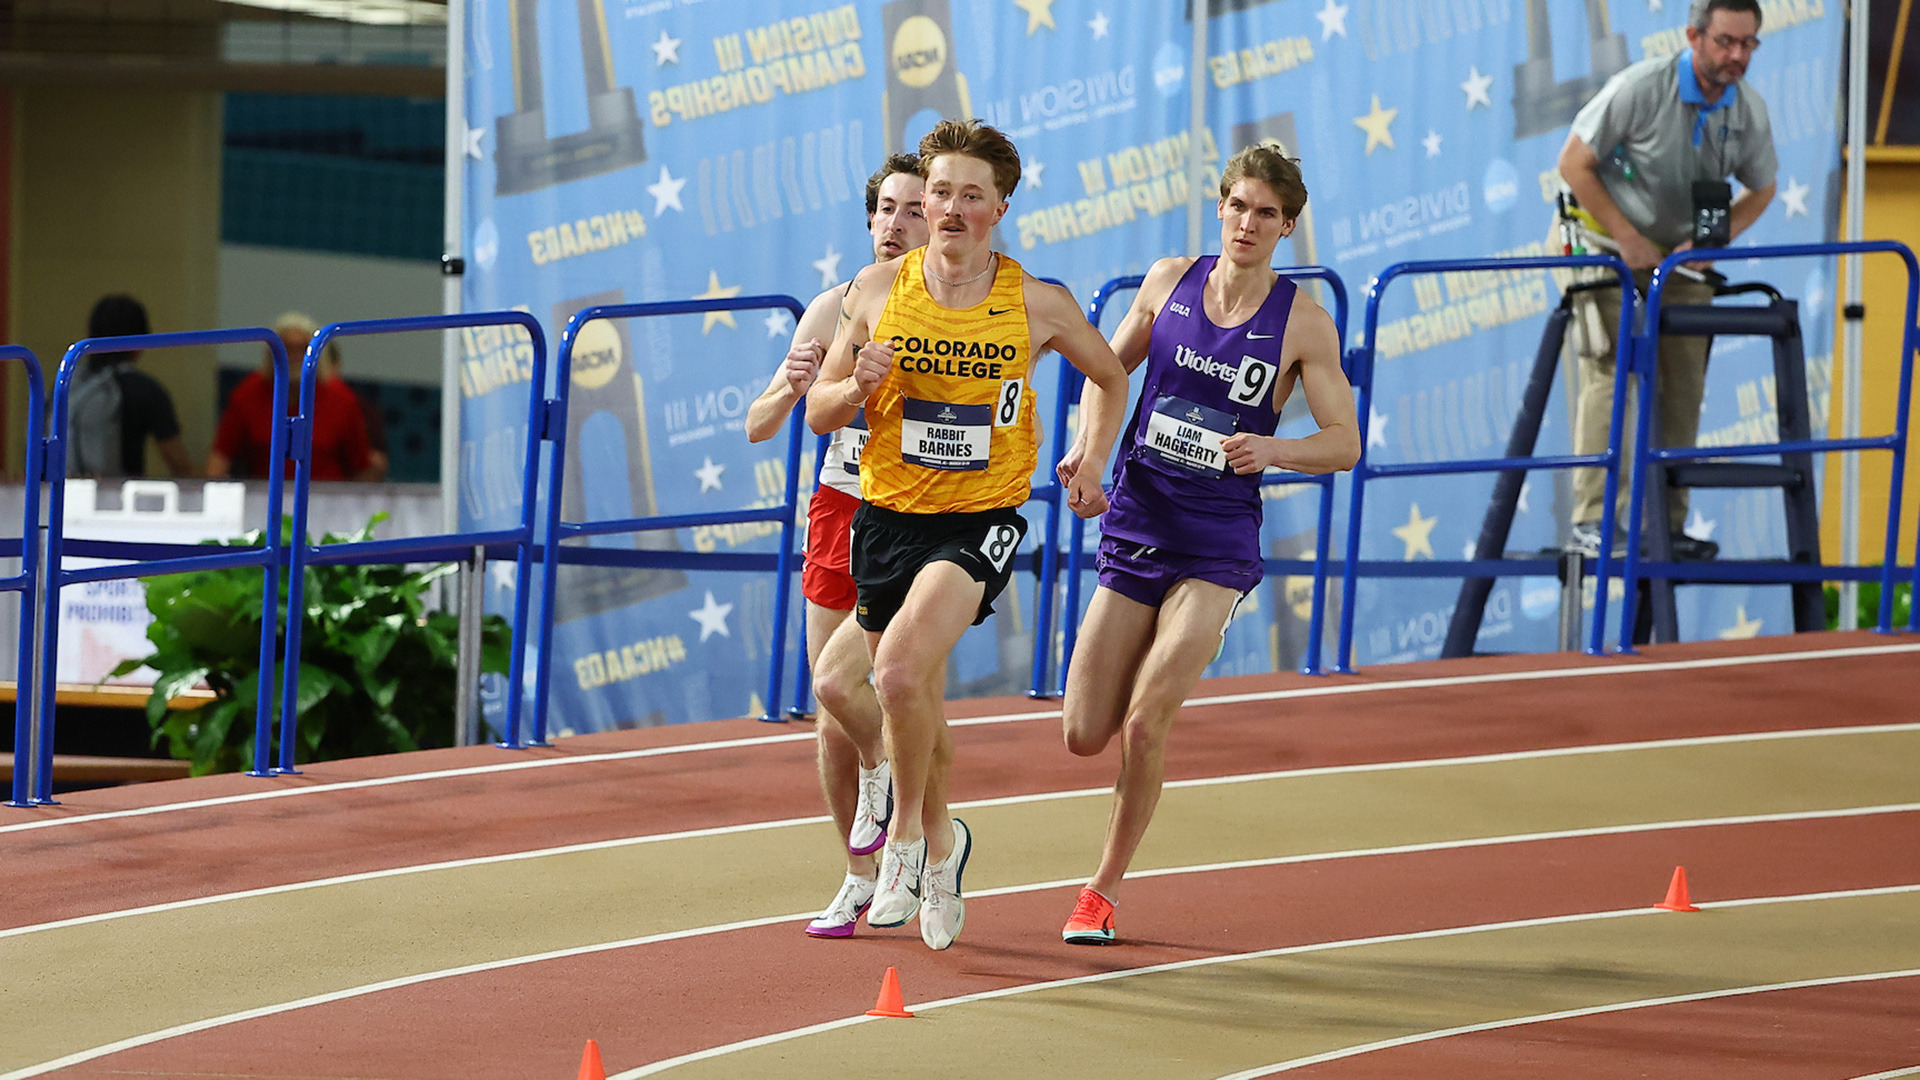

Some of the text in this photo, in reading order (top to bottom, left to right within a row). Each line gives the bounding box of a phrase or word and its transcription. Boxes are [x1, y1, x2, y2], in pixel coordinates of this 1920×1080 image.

[1170, 302, 1191, 318] UAA
[891, 335, 1016, 361] COLORADO
[900, 355, 1003, 379] COLLEGE
[1174, 343, 1238, 384] Violets
[1238, 362, 1266, 401] 9
[1000, 381, 1019, 424] 8
[927, 427, 966, 441] RABBIT
[1177, 425, 1202, 443] LIAM
[919, 440, 972, 457] BARNES
[1155, 432, 1218, 464] HAGGERTY
[989, 525, 1015, 563] 8
